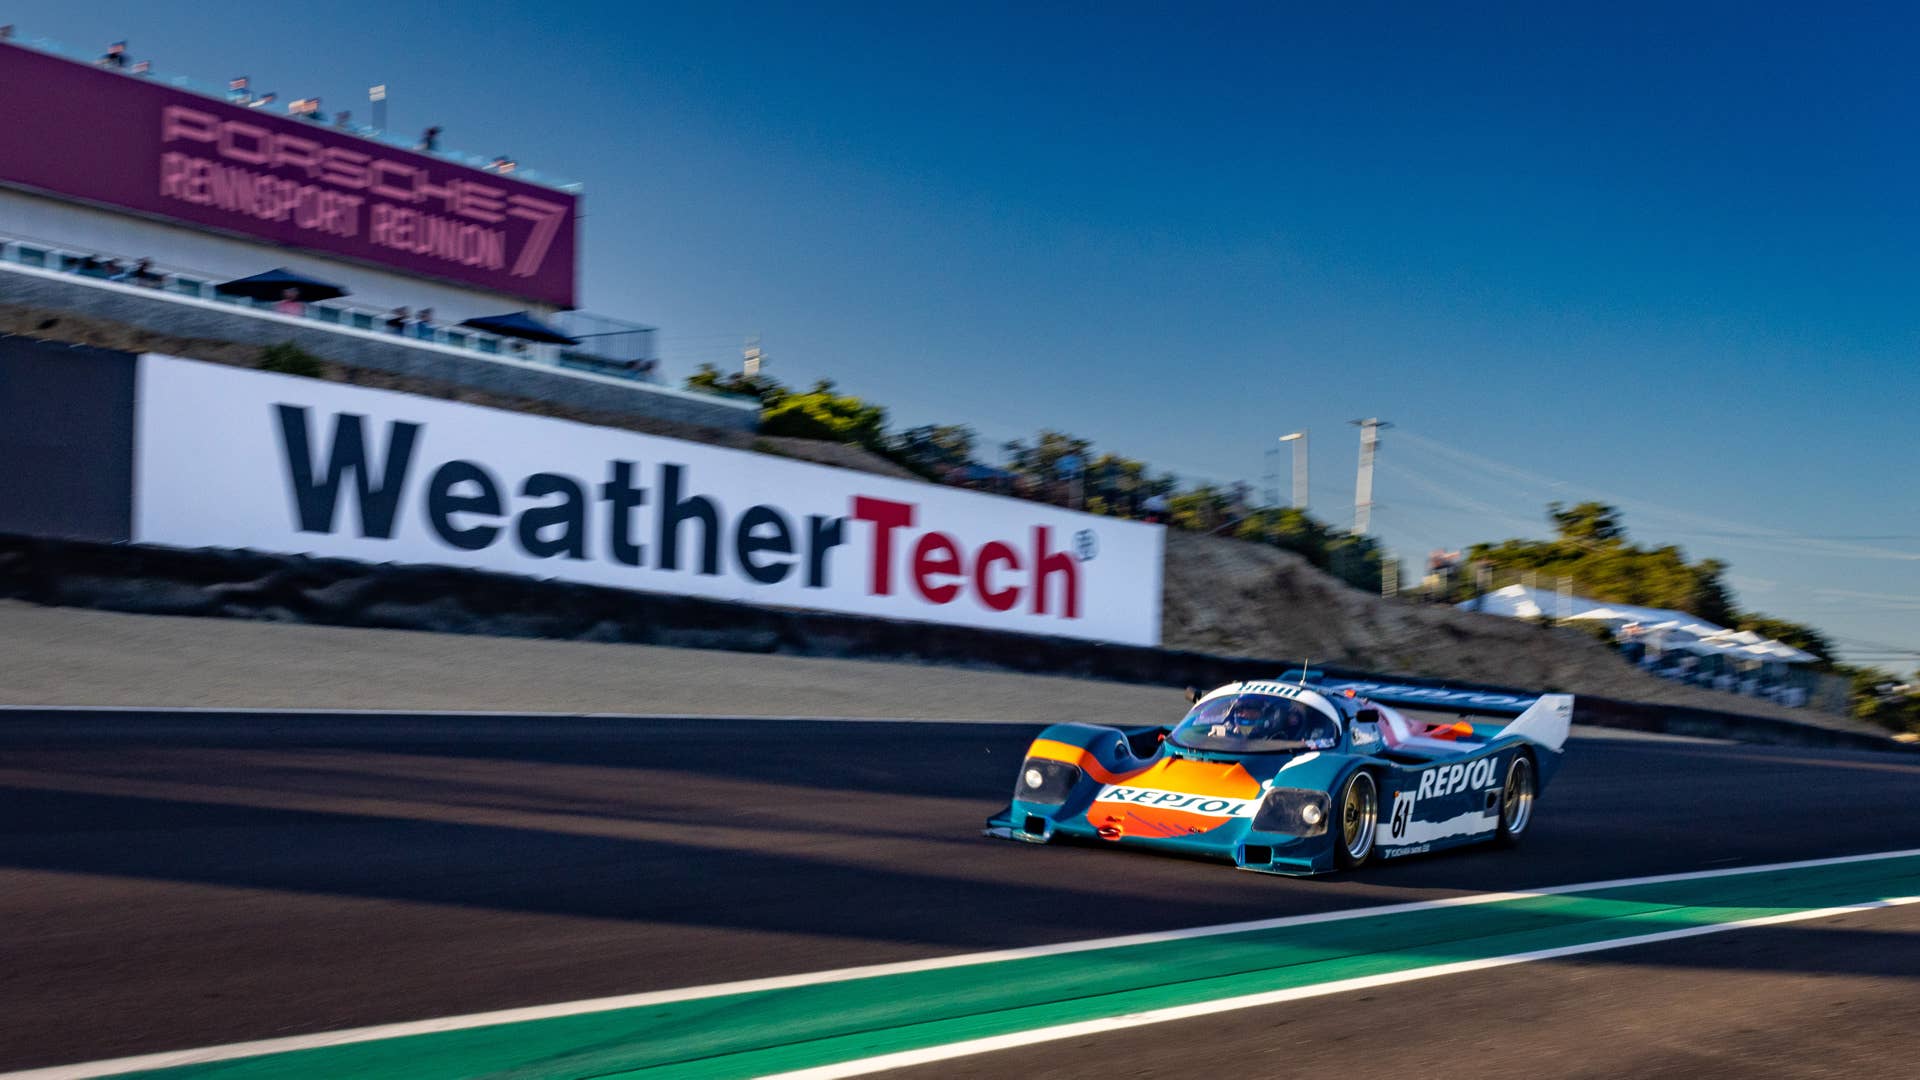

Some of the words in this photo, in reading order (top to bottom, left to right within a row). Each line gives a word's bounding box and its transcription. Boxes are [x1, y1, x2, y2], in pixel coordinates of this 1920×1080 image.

[161, 104, 507, 223] PORSCHE
[159, 151, 364, 238] RENNSPORT
[369, 203, 506, 271] REUNION
[506, 194, 569, 279] 7
[1416, 756, 1499, 801] REPSOL
[1104, 787, 1247, 816] REPSOL
[1391, 799, 1411, 839] 61
